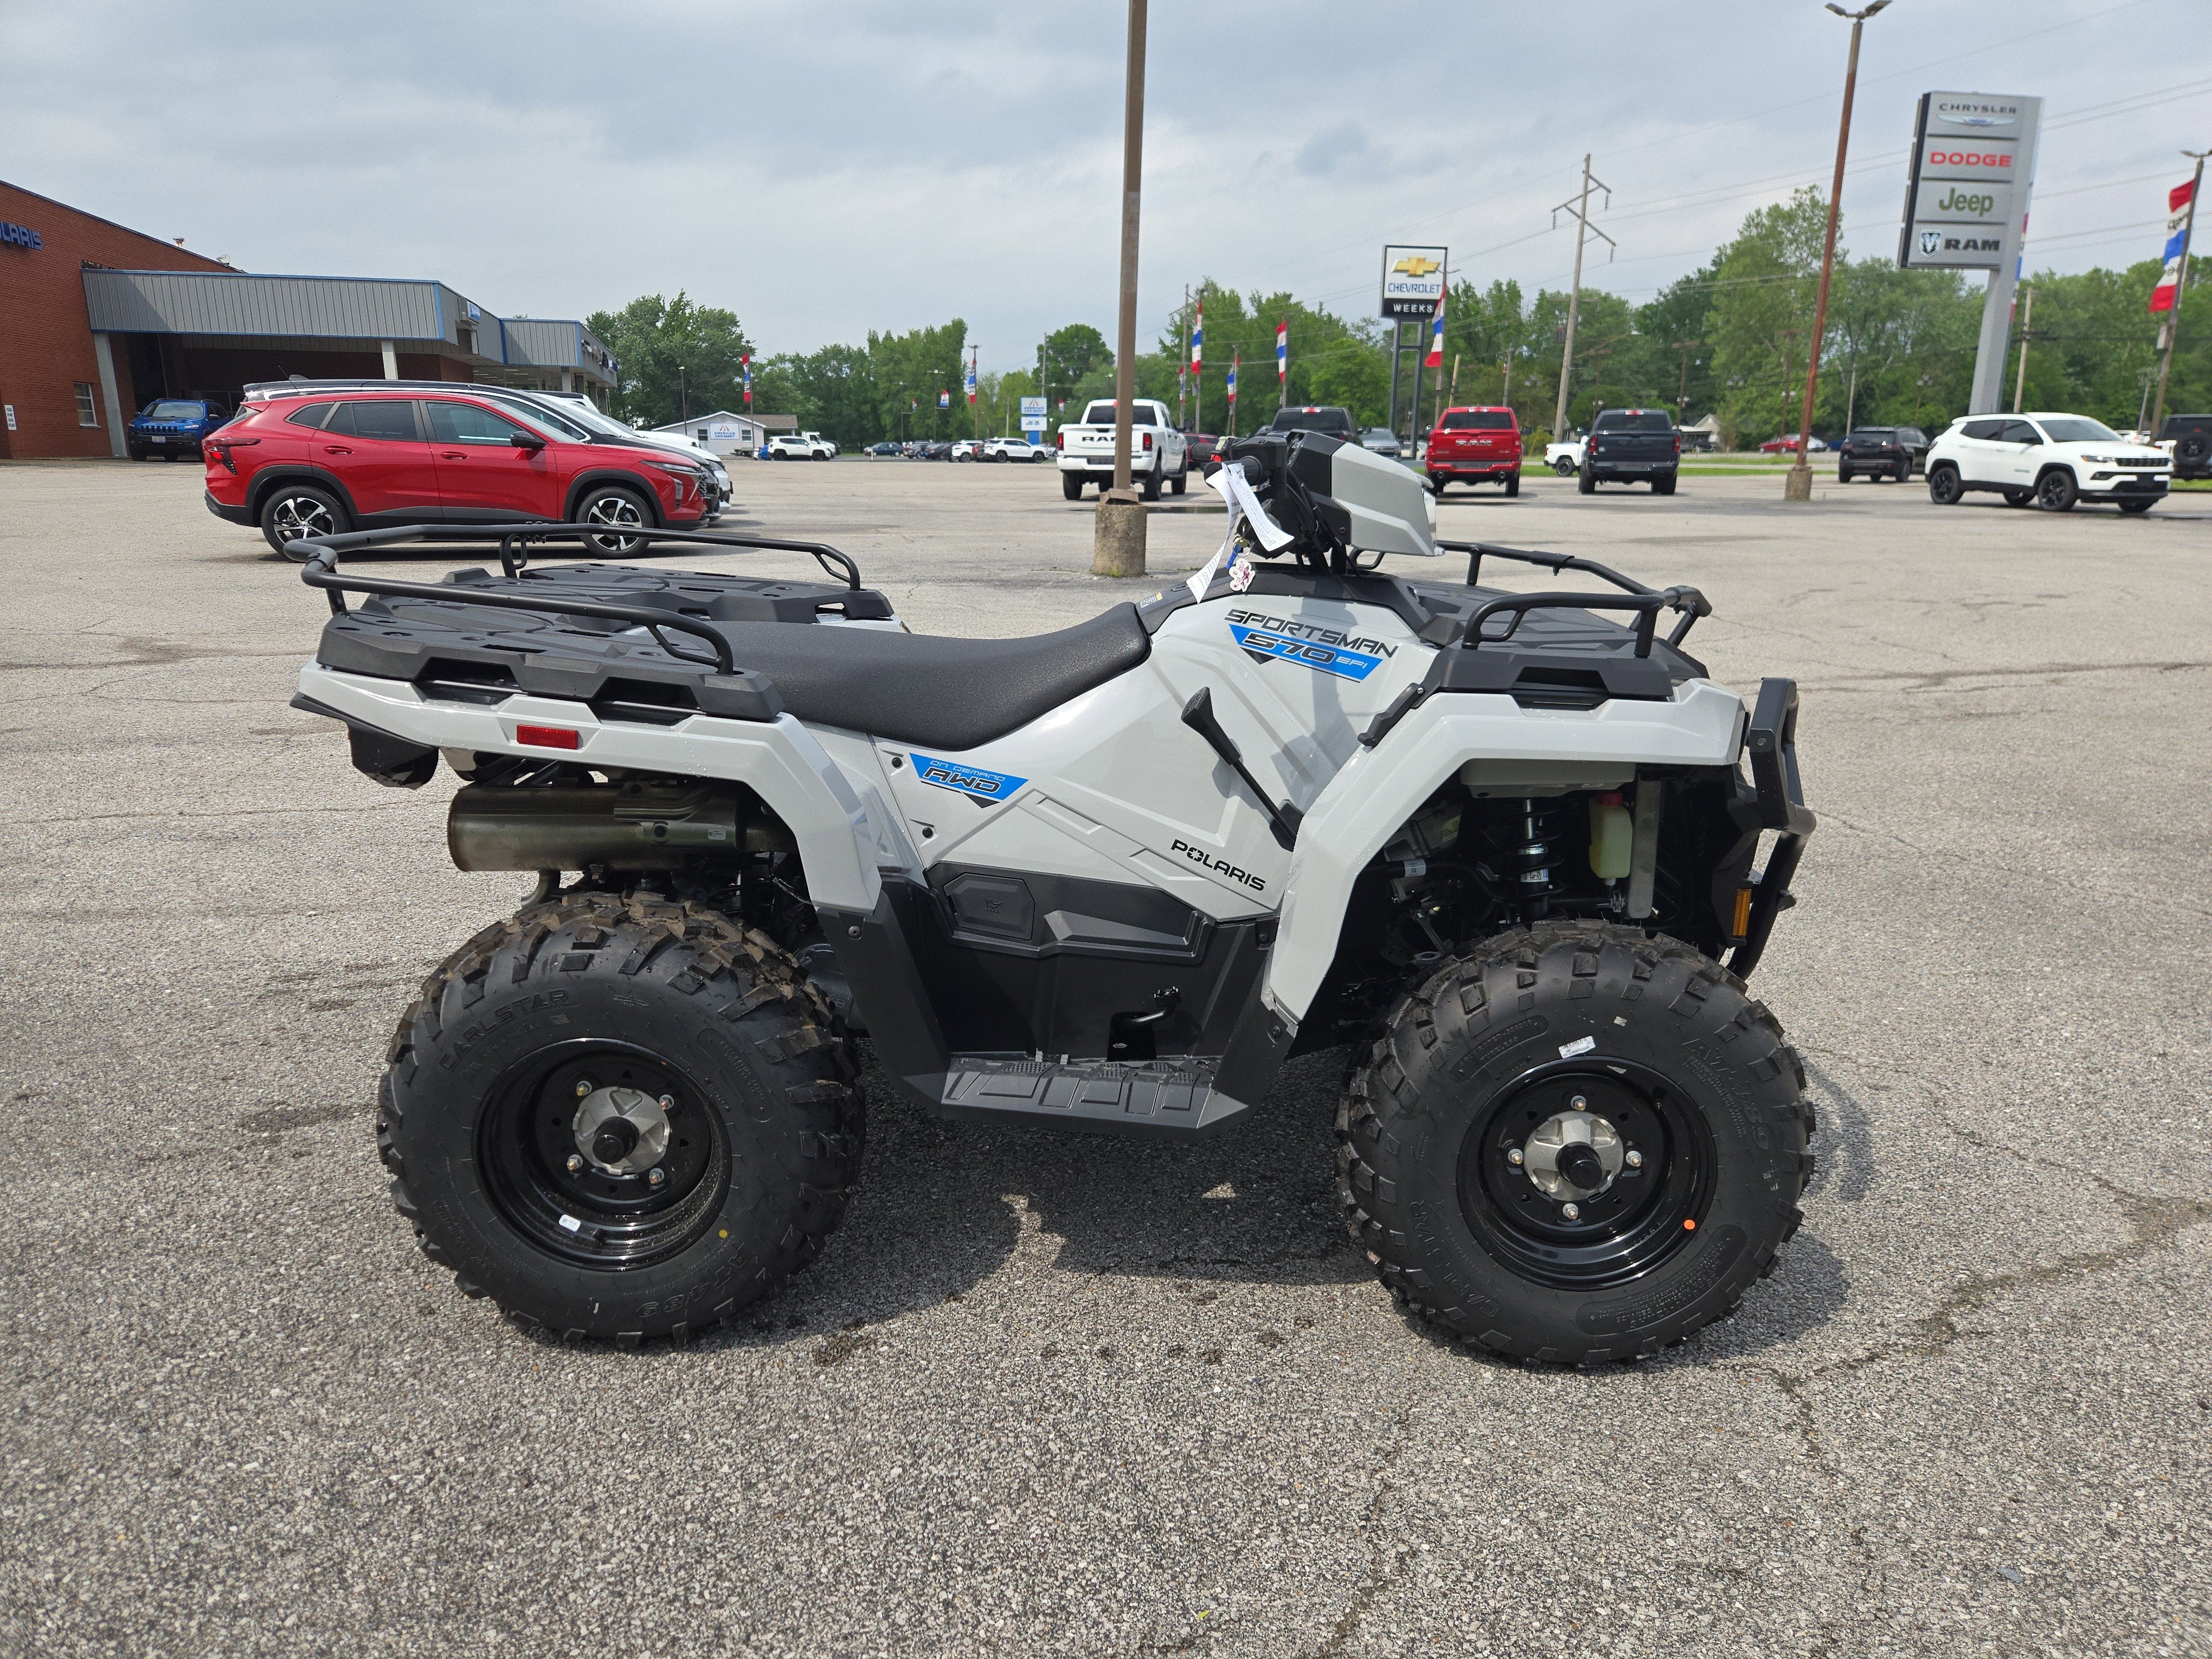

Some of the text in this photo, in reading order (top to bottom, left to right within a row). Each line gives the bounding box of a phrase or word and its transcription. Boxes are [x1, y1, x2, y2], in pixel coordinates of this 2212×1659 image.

[1938, 102, 2017, 114] CHRYSLER
[1930, 151, 2012, 168] DODGE
[1938, 187, 1994, 216] Jeep
[1944, 237, 2001, 251] RAM
[1388, 282, 1441, 293] CHEVROLET
[1393, 303, 1434, 313] WEEKS
[1224, 609, 1399, 658] SPORTSMAN
[1242, 632, 1368, 669] 570 EFI
[923, 767, 1001, 793] AWD
[953, 766, 1006, 781] DEMAND
[1170, 839, 1266, 891] POLARIS
[439, 988, 570, 1071] CARLSTAR
[1409, 1200, 1500, 1318] CARLSTAR
